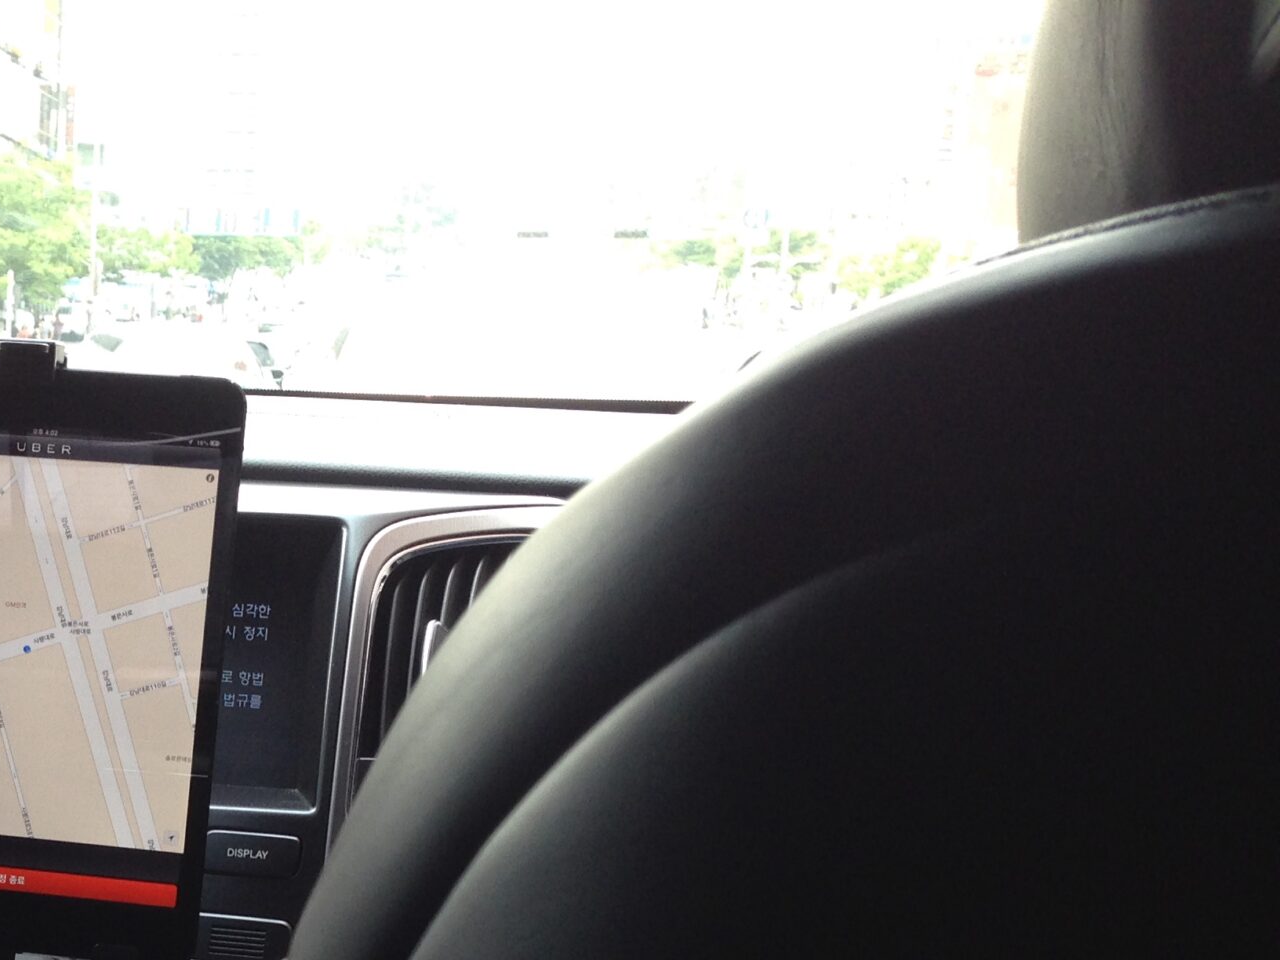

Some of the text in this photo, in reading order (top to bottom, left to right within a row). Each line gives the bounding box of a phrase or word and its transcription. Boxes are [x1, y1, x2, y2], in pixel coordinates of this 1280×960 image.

[16, 442, 71, 455] UBER
[232, 603, 272, 619] 심각한
[224, 625, 269, 641] 시 정지
[221, 669, 264, 686] 로 항법
[223, 692, 262, 709] 법규를
[226, 847, 269, 860] DISPLAY
